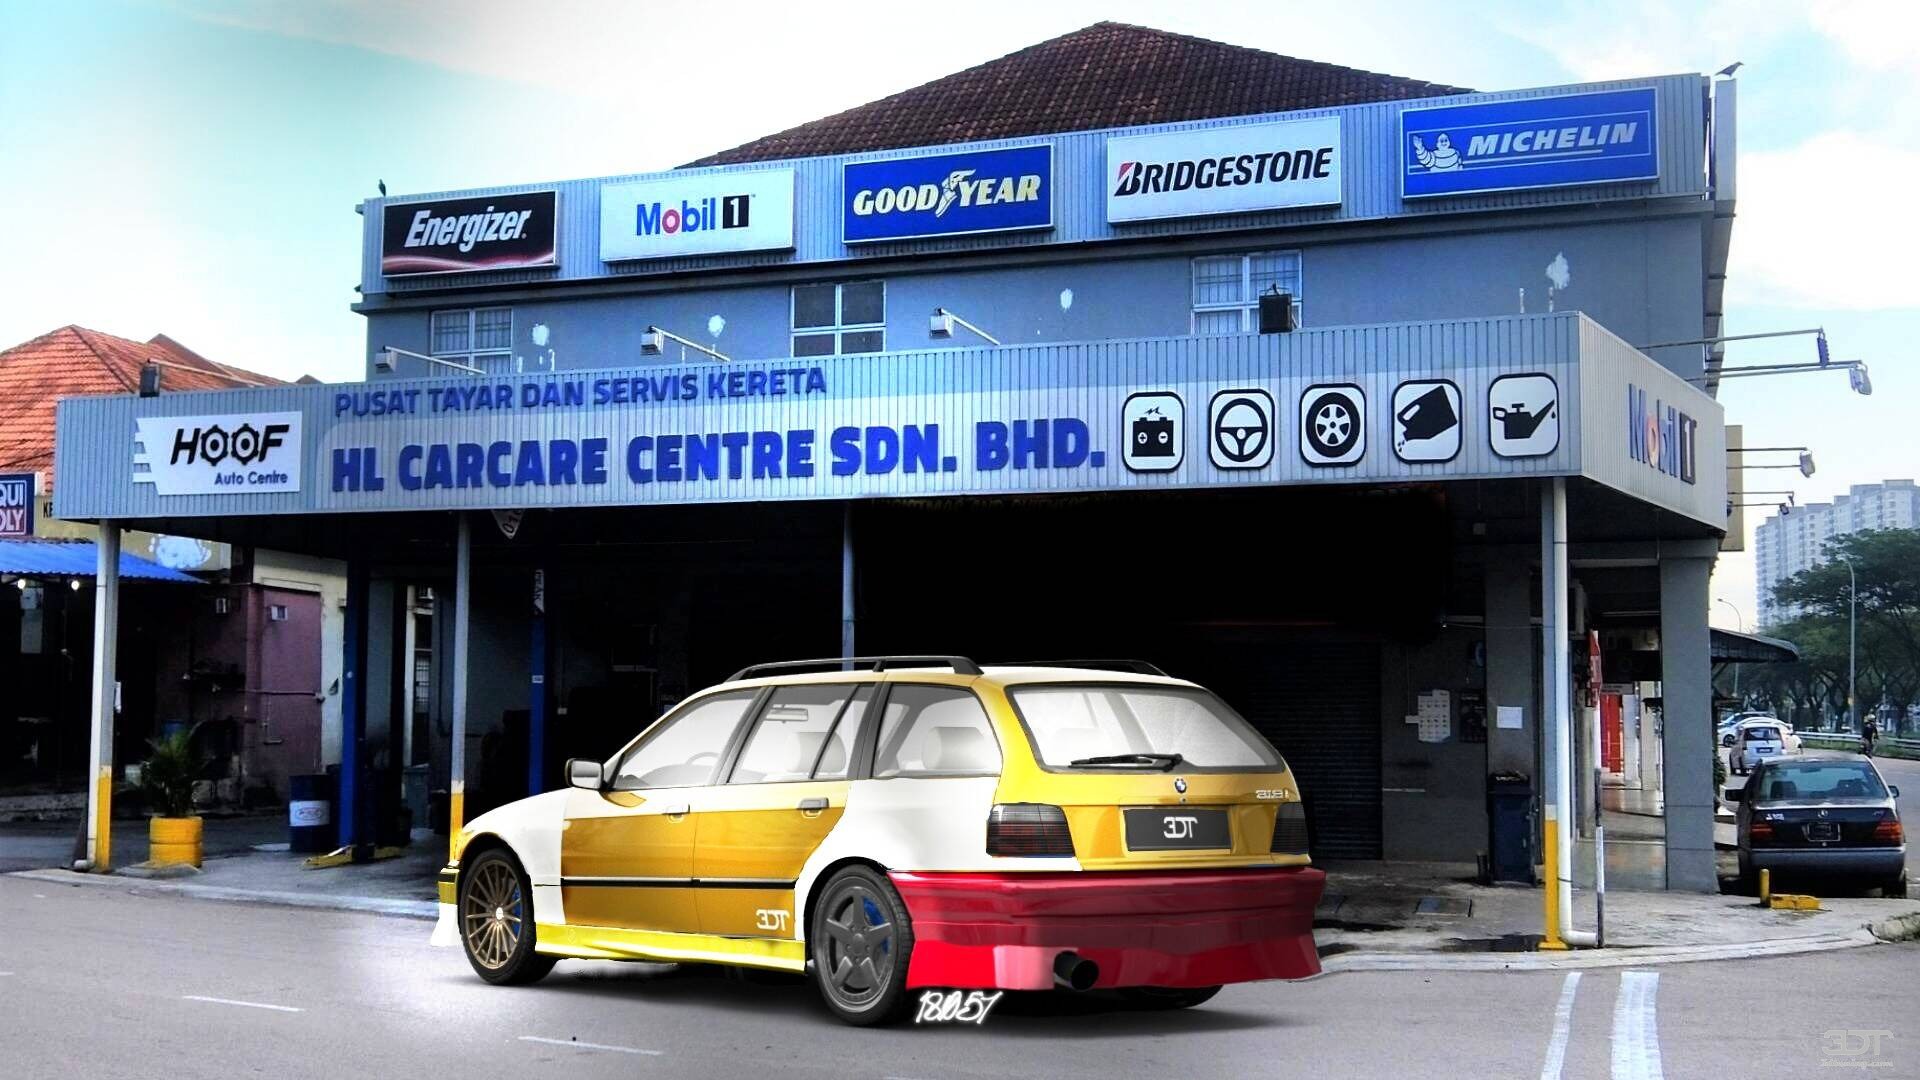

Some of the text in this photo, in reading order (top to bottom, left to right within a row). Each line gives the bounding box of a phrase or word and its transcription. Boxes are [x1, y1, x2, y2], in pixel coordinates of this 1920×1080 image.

[1467, 122, 1638, 157] MICHELIN
[1115, 147, 1333, 197] BRIDGESTONE
[404, 206, 532, 253] Energizer
[636, 194, 750, 237] Mobil 1
[334, 367, 827, 418] PUSAT TAYAR DAN SERVIS KERETA
[170, 423, 289, 467] HOOF
[1629, 383, 1678, 478] Mobil
[214, 469, 289, 486] Auto Centre
[331, 417, 1106, 492] HL CARCARE CENTRE SDN. BHD.
